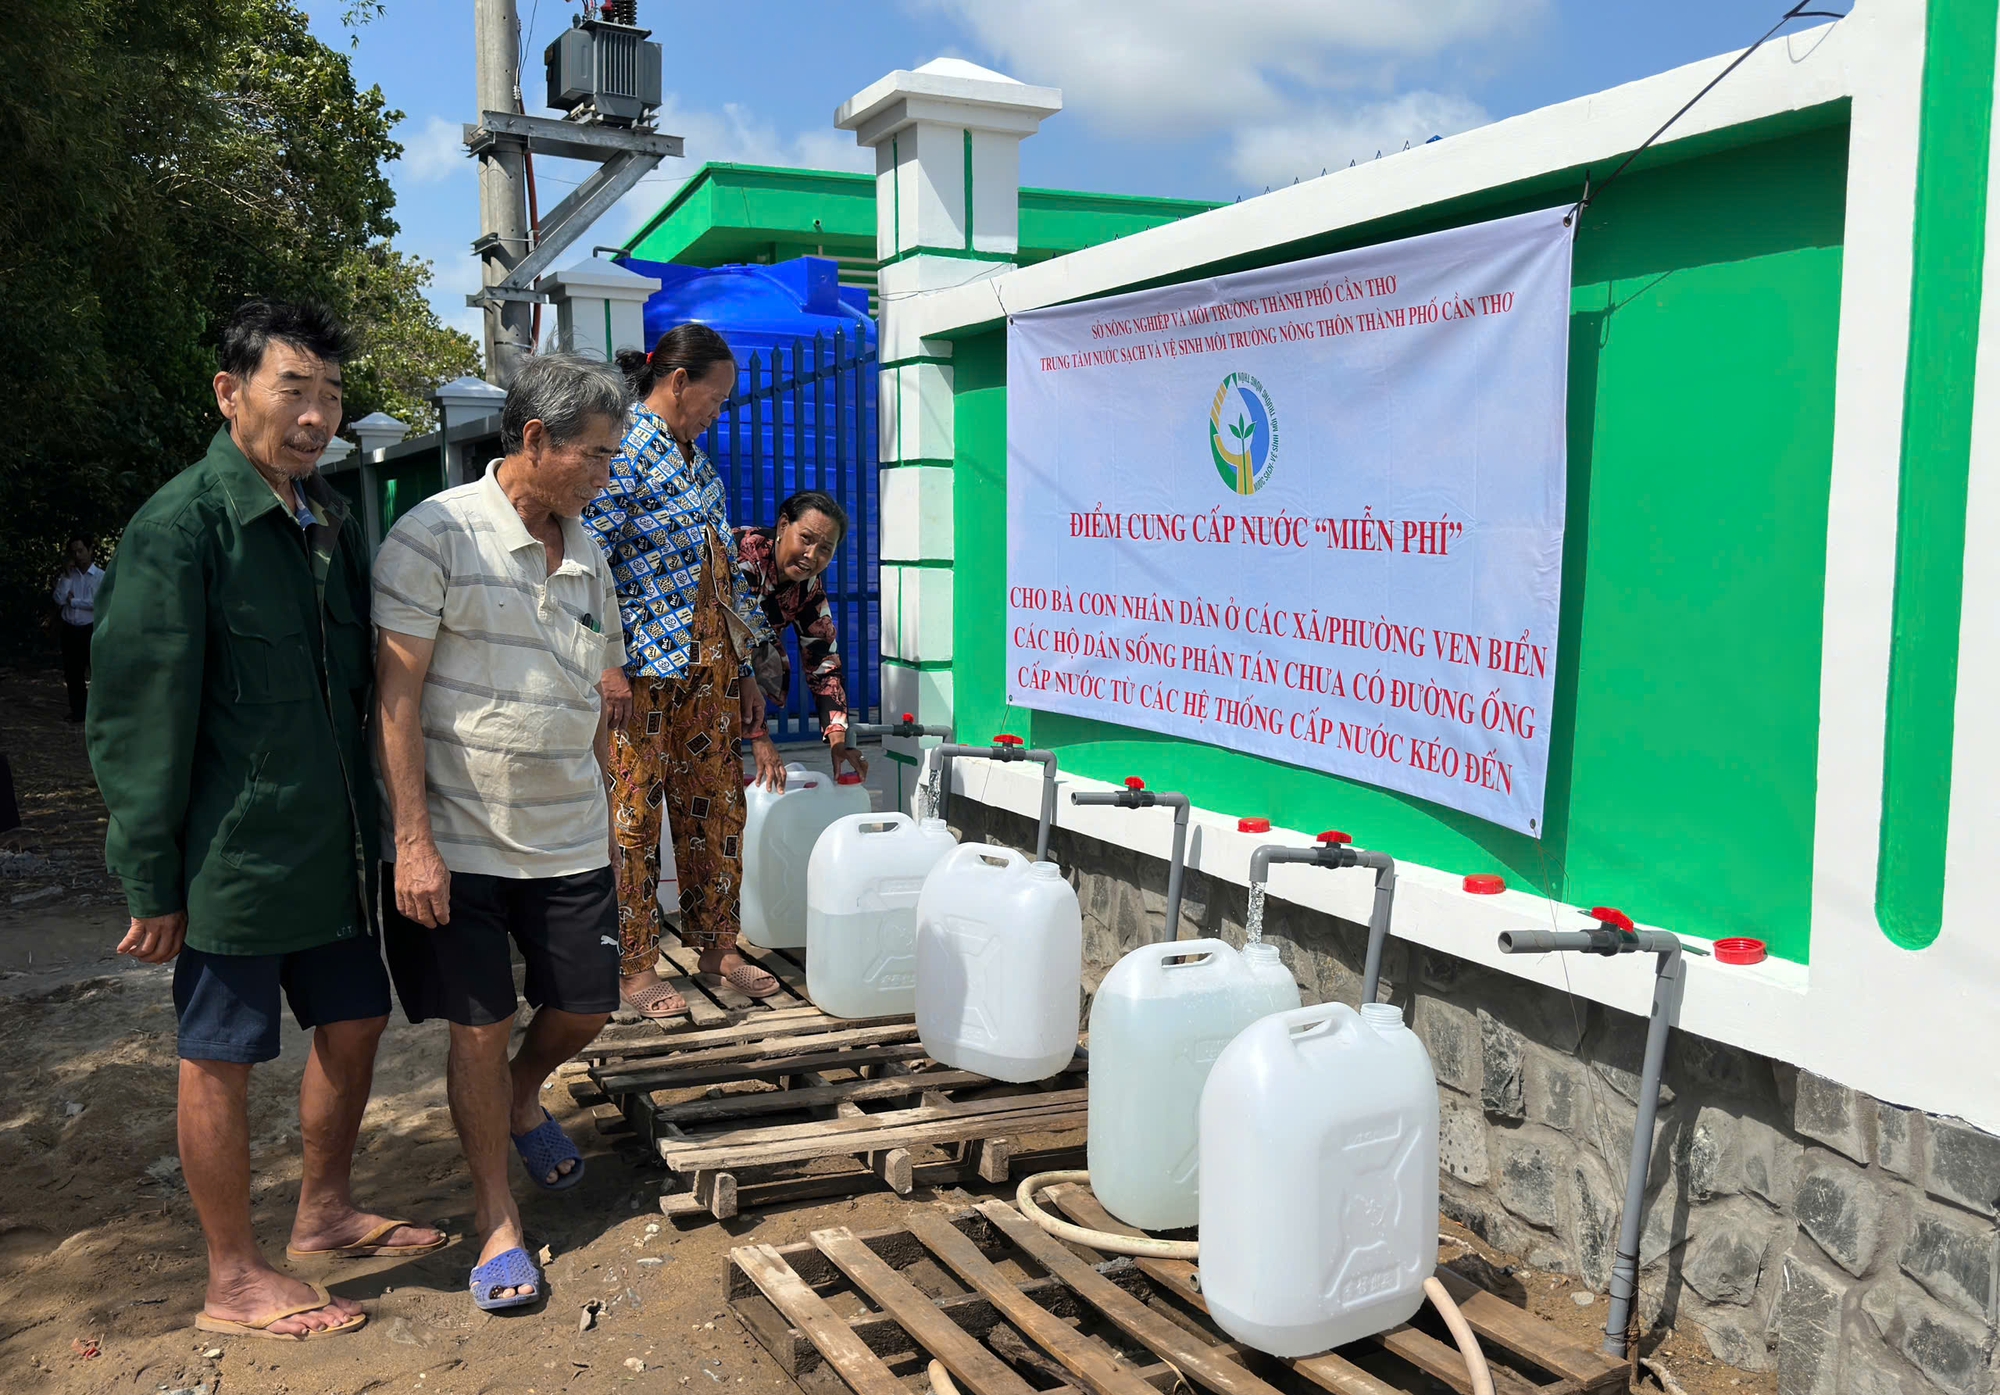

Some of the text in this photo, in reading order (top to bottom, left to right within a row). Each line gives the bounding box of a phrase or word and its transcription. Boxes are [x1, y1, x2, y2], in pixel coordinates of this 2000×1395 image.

[1040, 291, 1515, 371] TRUNG TÂM NƯỚC SẠCH VÀ VỆ SINH MÔI TRƯỜNG NÔNG THÔN THÀNH PHỐ CẦN THƠ
[1091, 274, 1397, 339] SỞ NÔNG NGHIỆP VÀ MÔI TRƯỜNG THÀNH PHỐ CẦN THƠ
[1070, 502, 1122, 539] ĐIỂM
[1127, 513, 1186, 542] CUNG
[1192, 505, 1237, 544] CẤP
[1241, 508, 1309, 548] NƯỚC
[1010, 585, 1549, 679] CHO BÀ CON NHÂN DÂN Ở CÁC XÃ/PHƯỜNG VEN BIỂN
[1013, 623, 1536, 740] CÁC HỘ DÂN SỐNG PHÂN TÁN CHƯA CÓ ĐƯỜNG ỐNG
[1017, 661, 1513, 796] CẤP NƯỚC TỪ CÁC HỆ THỐNG CẤP NƯỚC KÉO ĐẾN
